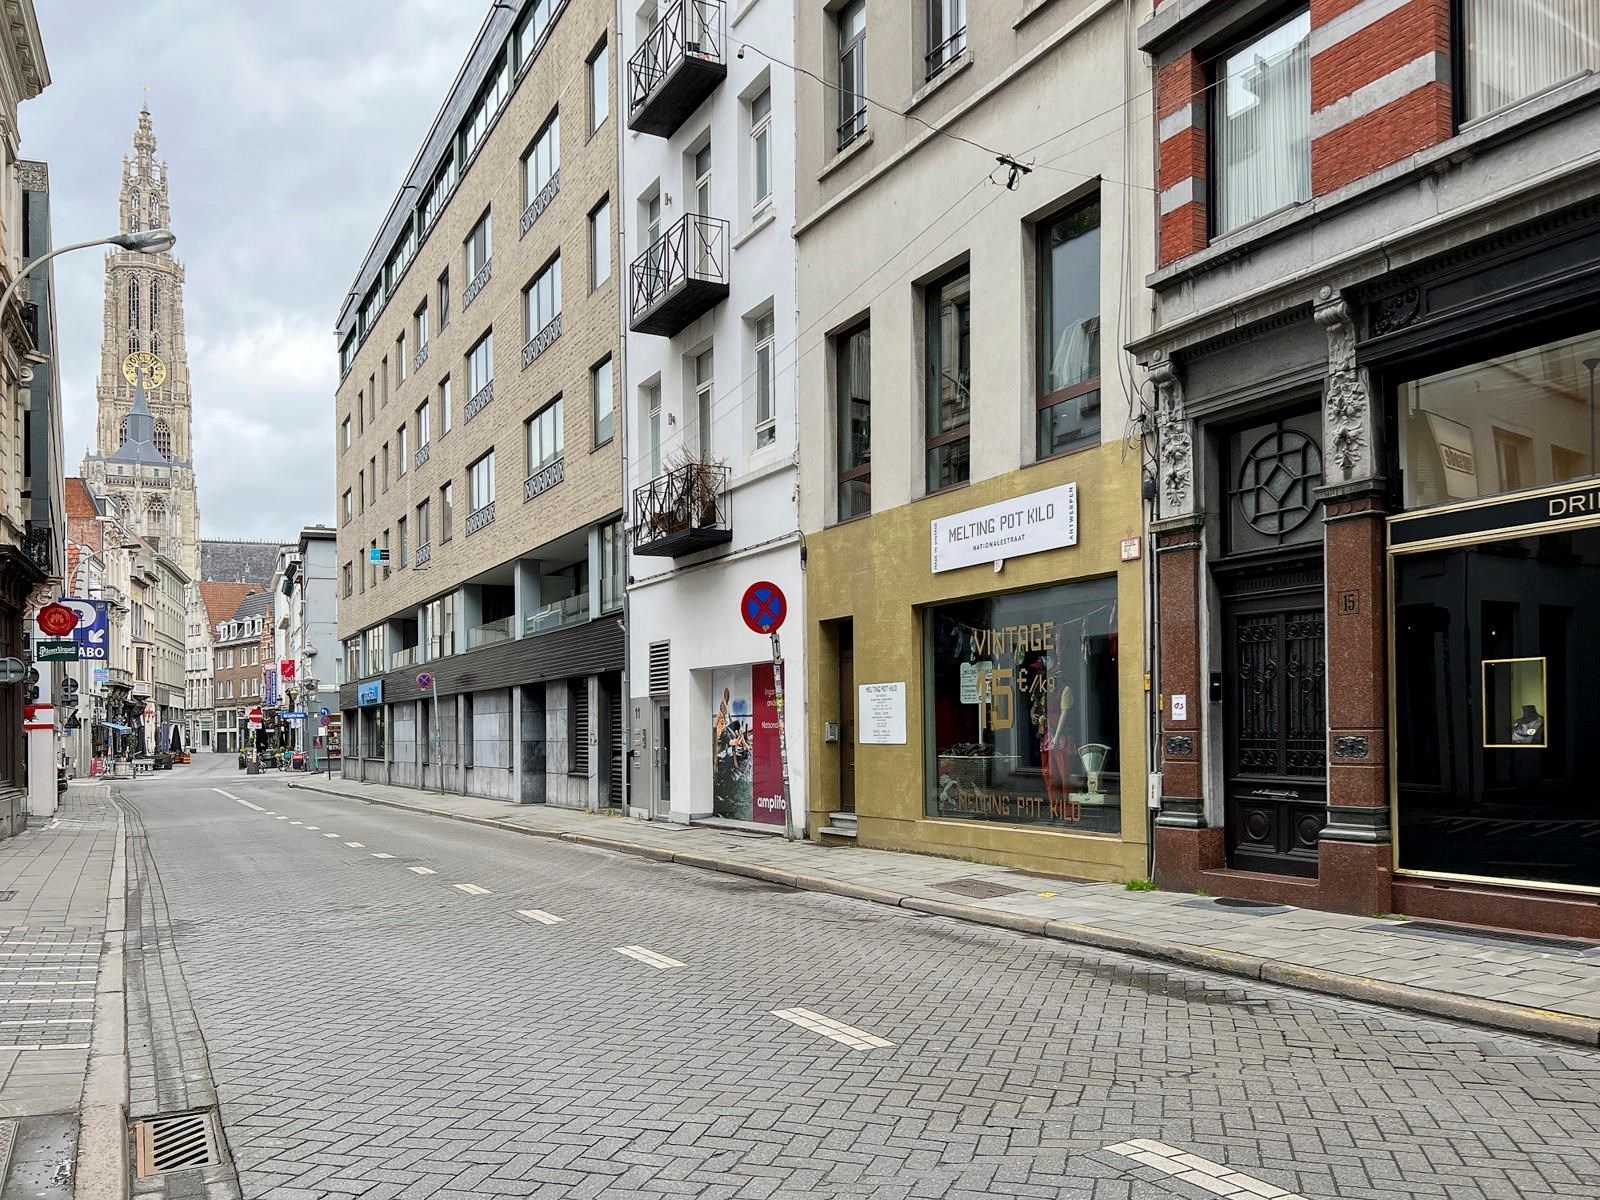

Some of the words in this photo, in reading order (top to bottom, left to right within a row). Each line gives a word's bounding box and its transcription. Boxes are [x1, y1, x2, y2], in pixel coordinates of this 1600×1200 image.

[948, 518, 995, 543] MELTING
[1000, 510, 1024, 531] POT
[1027, 503, 1054, 525] KILO
[972, 533, 1026, 551] NATIONALESTRAAT
[1343, 594, 1355, 612] 15
[974, 621, 1055, 656] VINTAGE
[634, 707, 641, 720] 11
[757, 794, 787, 813] amplifo
